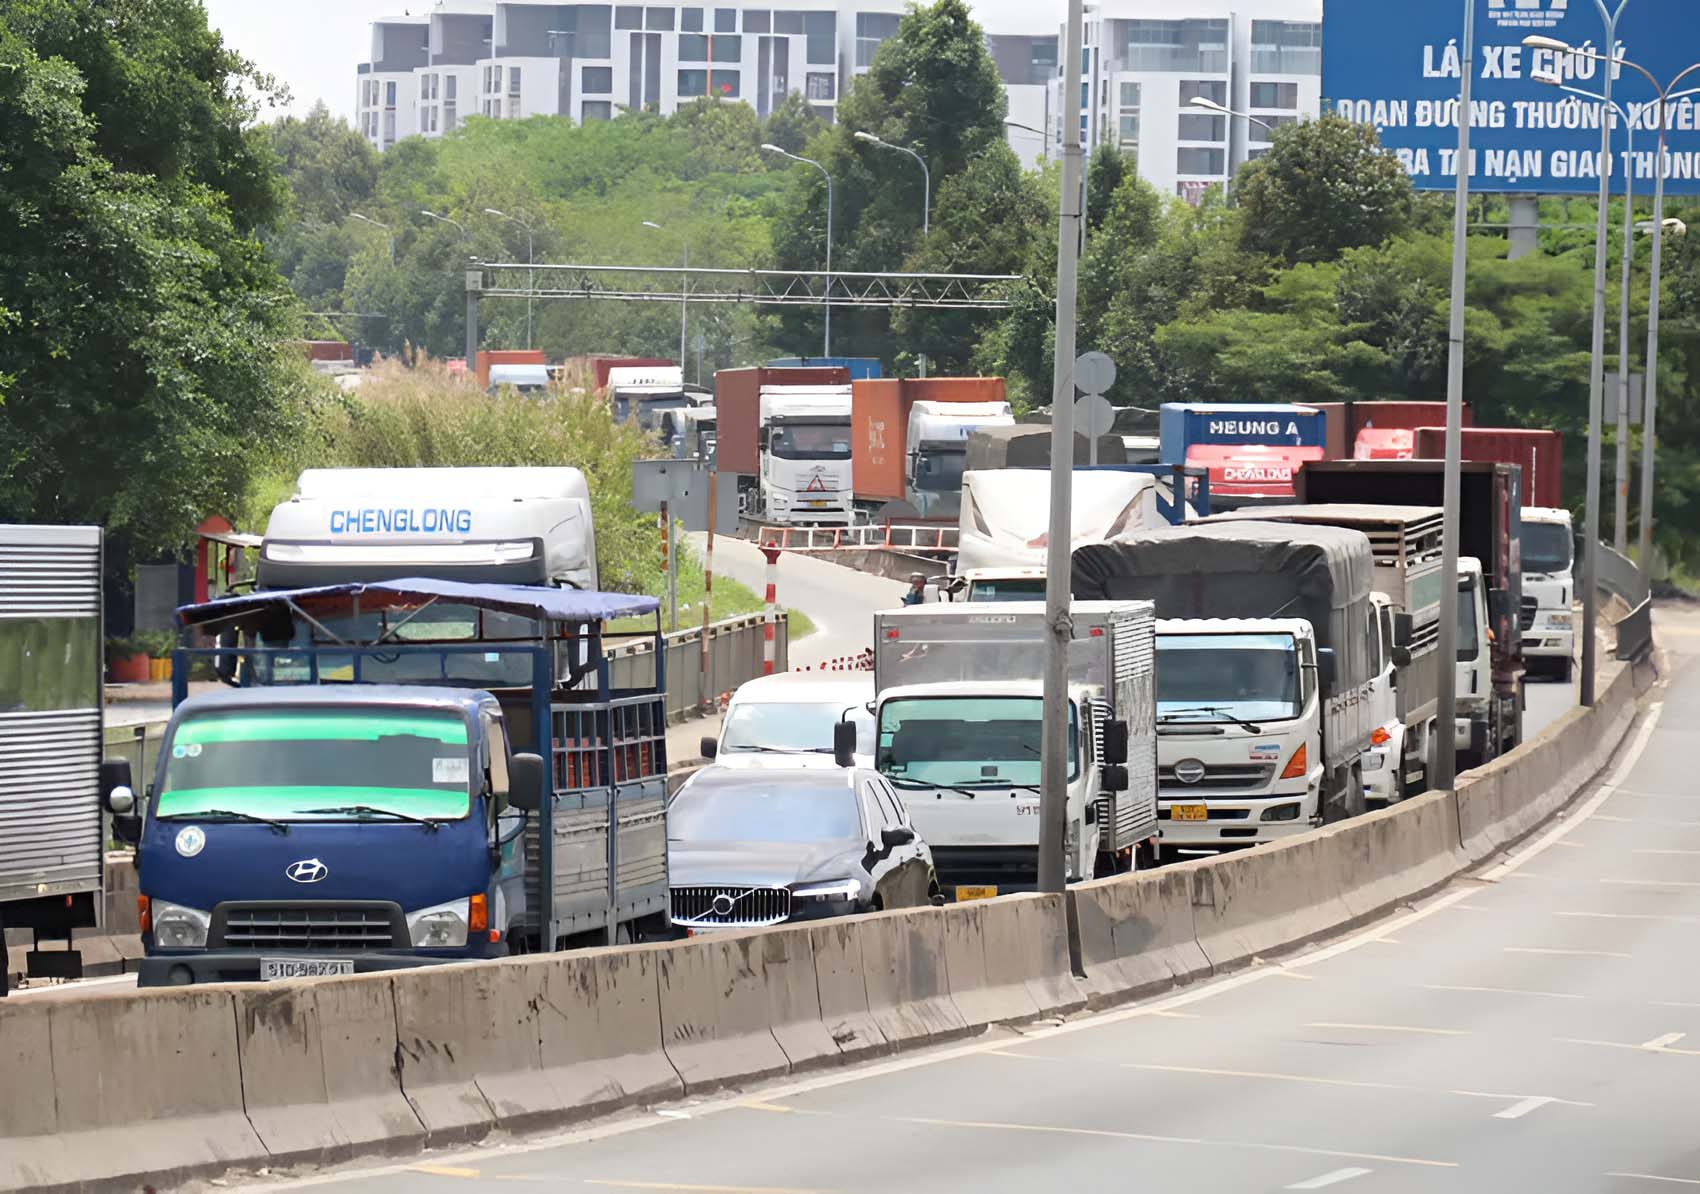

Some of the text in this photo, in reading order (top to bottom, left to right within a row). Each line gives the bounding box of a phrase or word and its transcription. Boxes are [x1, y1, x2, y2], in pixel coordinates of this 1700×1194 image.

[1423, 38, 1463, 78] LÁ
[1481, 45, 1522, 79] XE
[1530, 39, 1596, 80] CHÚ
[1485, 149, 1542, 183] NẠN
[1550, 150, 1613, 178] GIAO
[1209, 420, 1299, 435] HEUNG A
[330, 508, 472, 533] CHENGLONG
